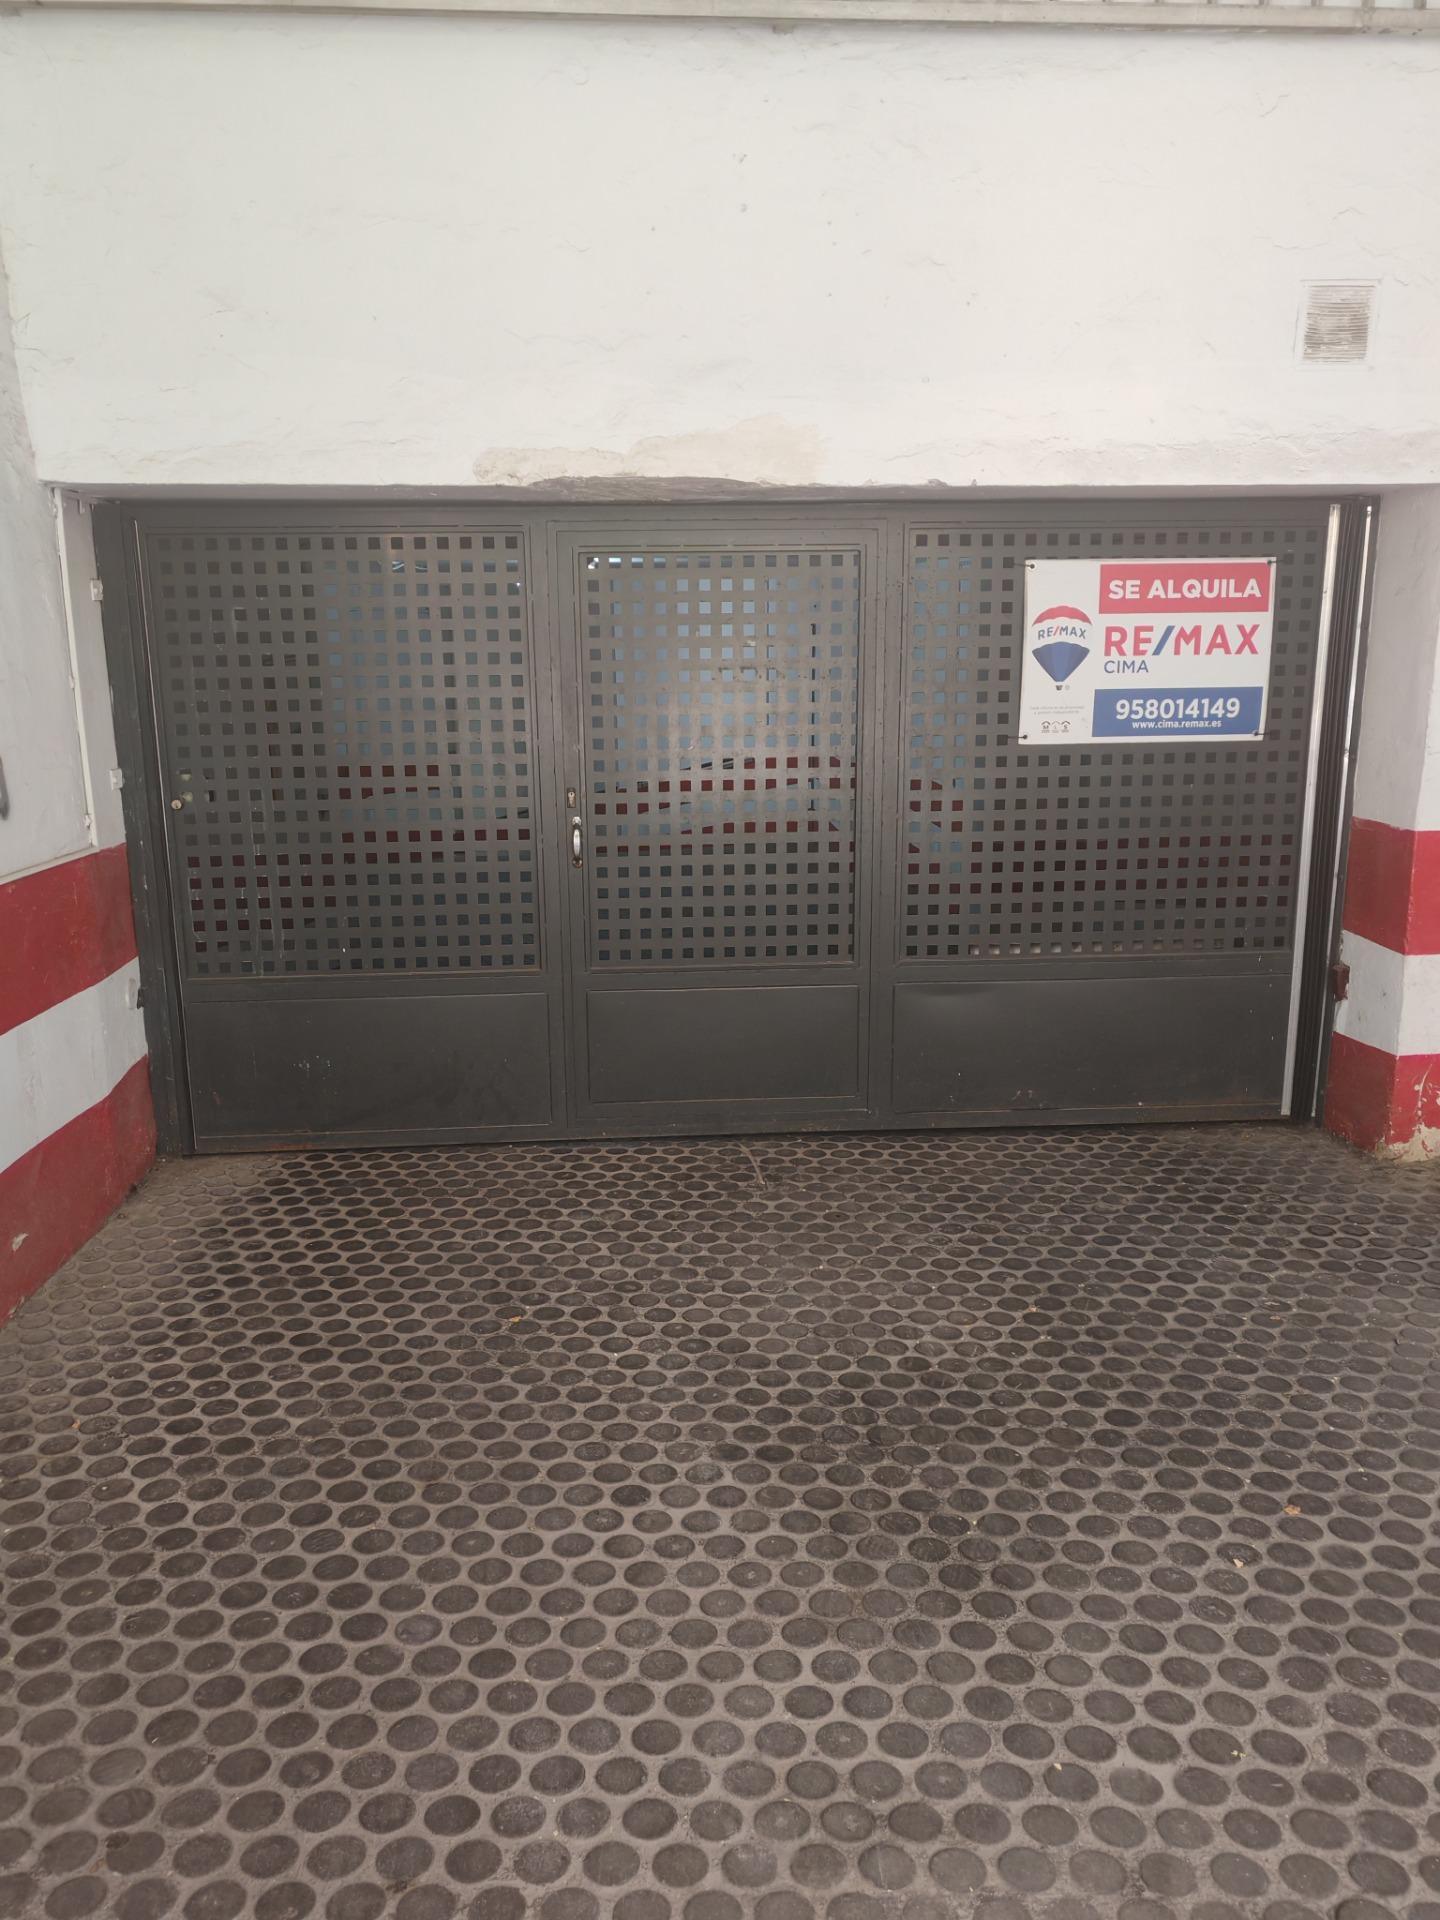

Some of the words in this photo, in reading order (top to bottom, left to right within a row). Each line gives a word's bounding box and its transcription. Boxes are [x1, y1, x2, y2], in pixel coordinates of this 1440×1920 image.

[1108, 580, 1141, 599] SE
[1147, 578, 1262, 599] ALQUILA
[1037, 625, 1087, 640] RE/MAX
[1104, 624, 1260, 656] RE/MAX
[1104, 660, 1149, 674] CIMA
[1115, 697, 1241, 720] 958014149
[1131, 719, 1222, 729] www.cima.remax.es
